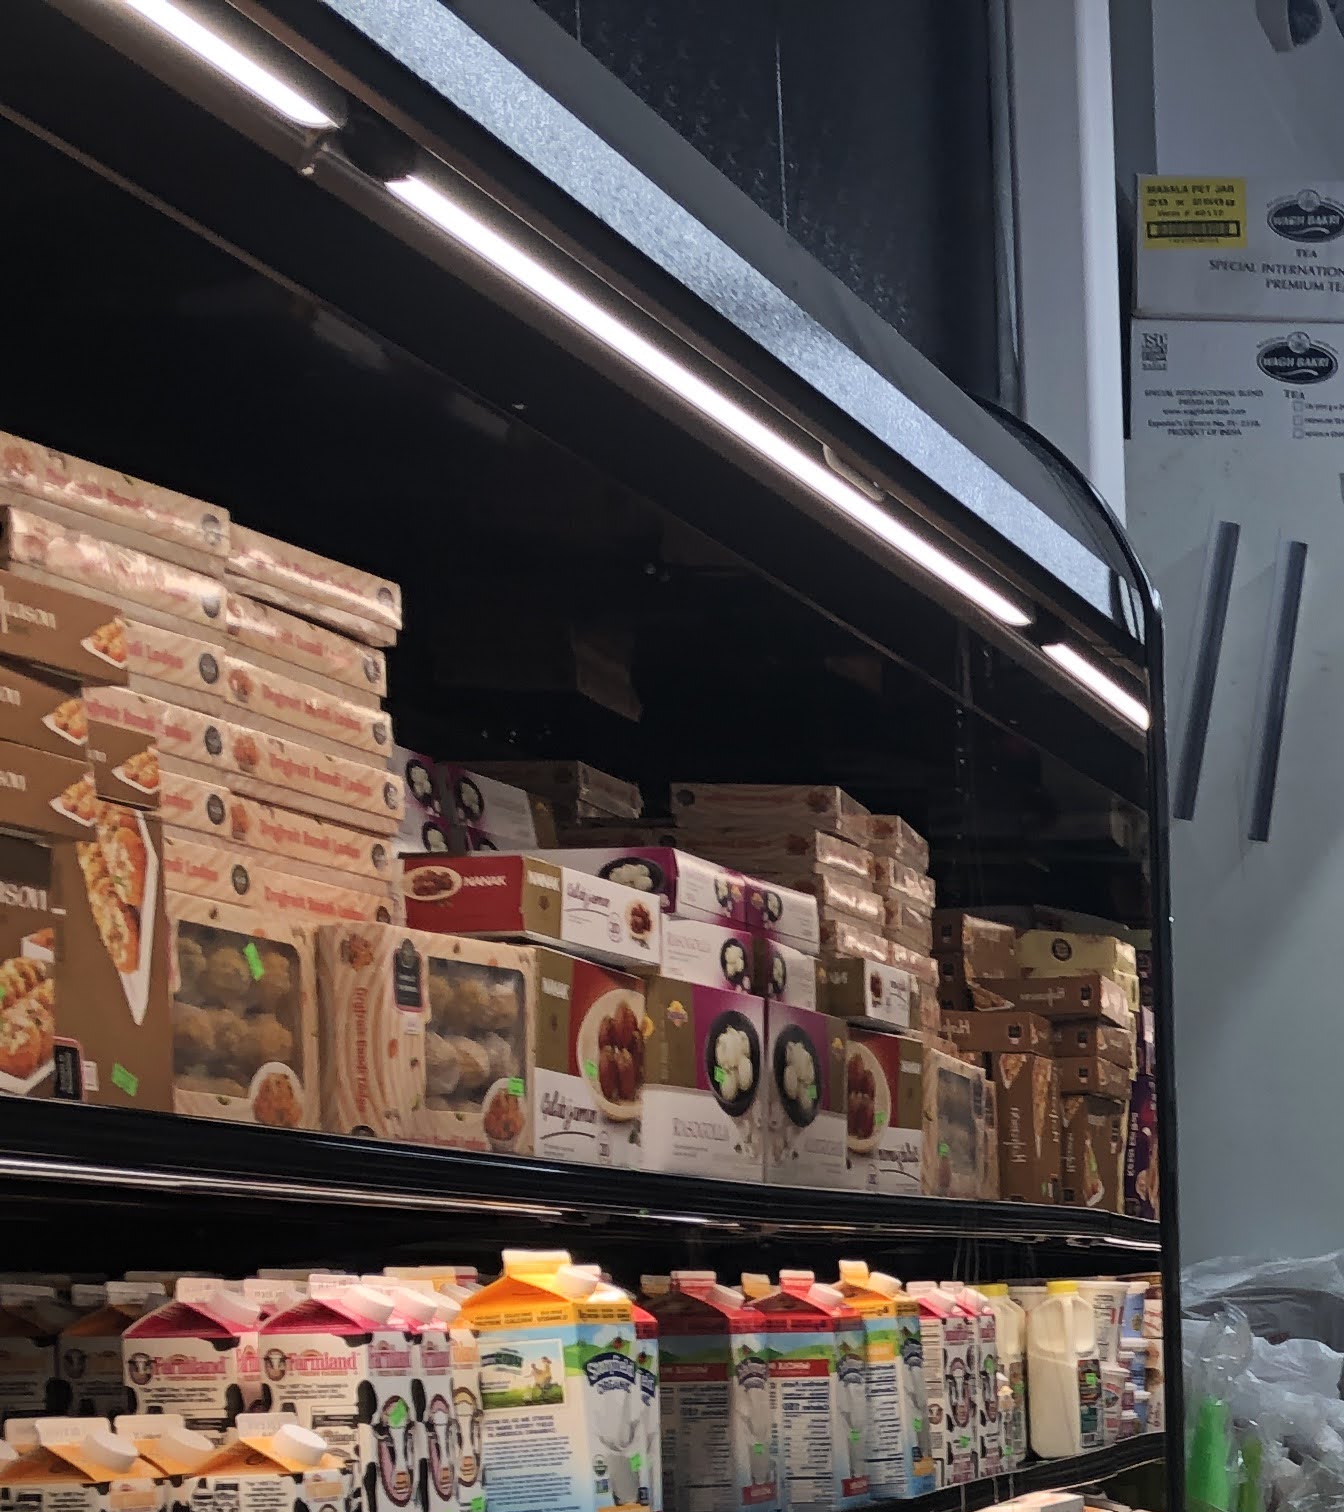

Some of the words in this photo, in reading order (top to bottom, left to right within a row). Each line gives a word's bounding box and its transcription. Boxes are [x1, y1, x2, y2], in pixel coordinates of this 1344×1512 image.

[1296, 249, 1318, 260] TEA
[1208, 259, 1256, 274] SPECIAL
[1265, 278, 1325, 292] PREMIUM
[1284, 389, 1306, 400] TEA
[153, 1355, 228, 1375] Farmland
[286, 1351, 357, 1371] Farmland
